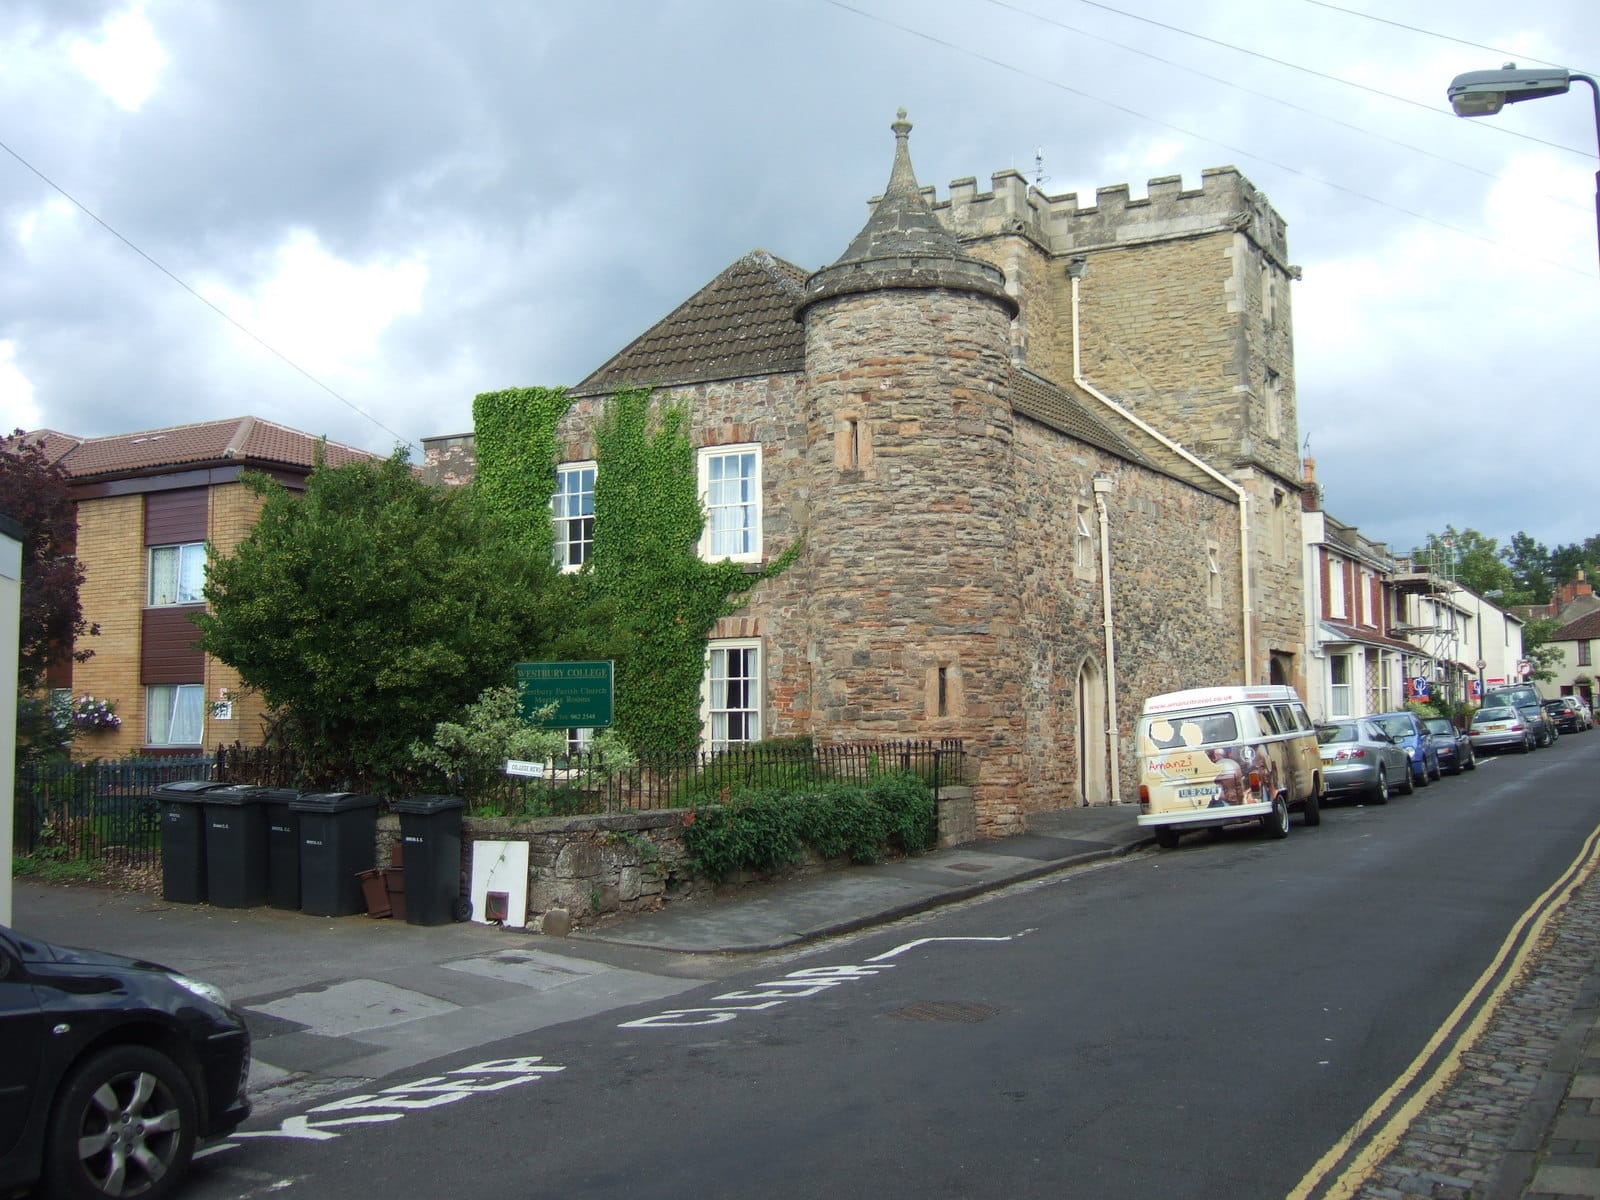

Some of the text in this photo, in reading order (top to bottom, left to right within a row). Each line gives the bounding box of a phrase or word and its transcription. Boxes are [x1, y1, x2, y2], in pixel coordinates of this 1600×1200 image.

[517, 668, 608, 677] WESTBURY COLLEGE
[522, 689, 552, 697] estbury
[580, 687, 608, 695] Church
[1149, 754, 1193, 771] Amanzi
[617, 965, 896, 1027] CLEAR
